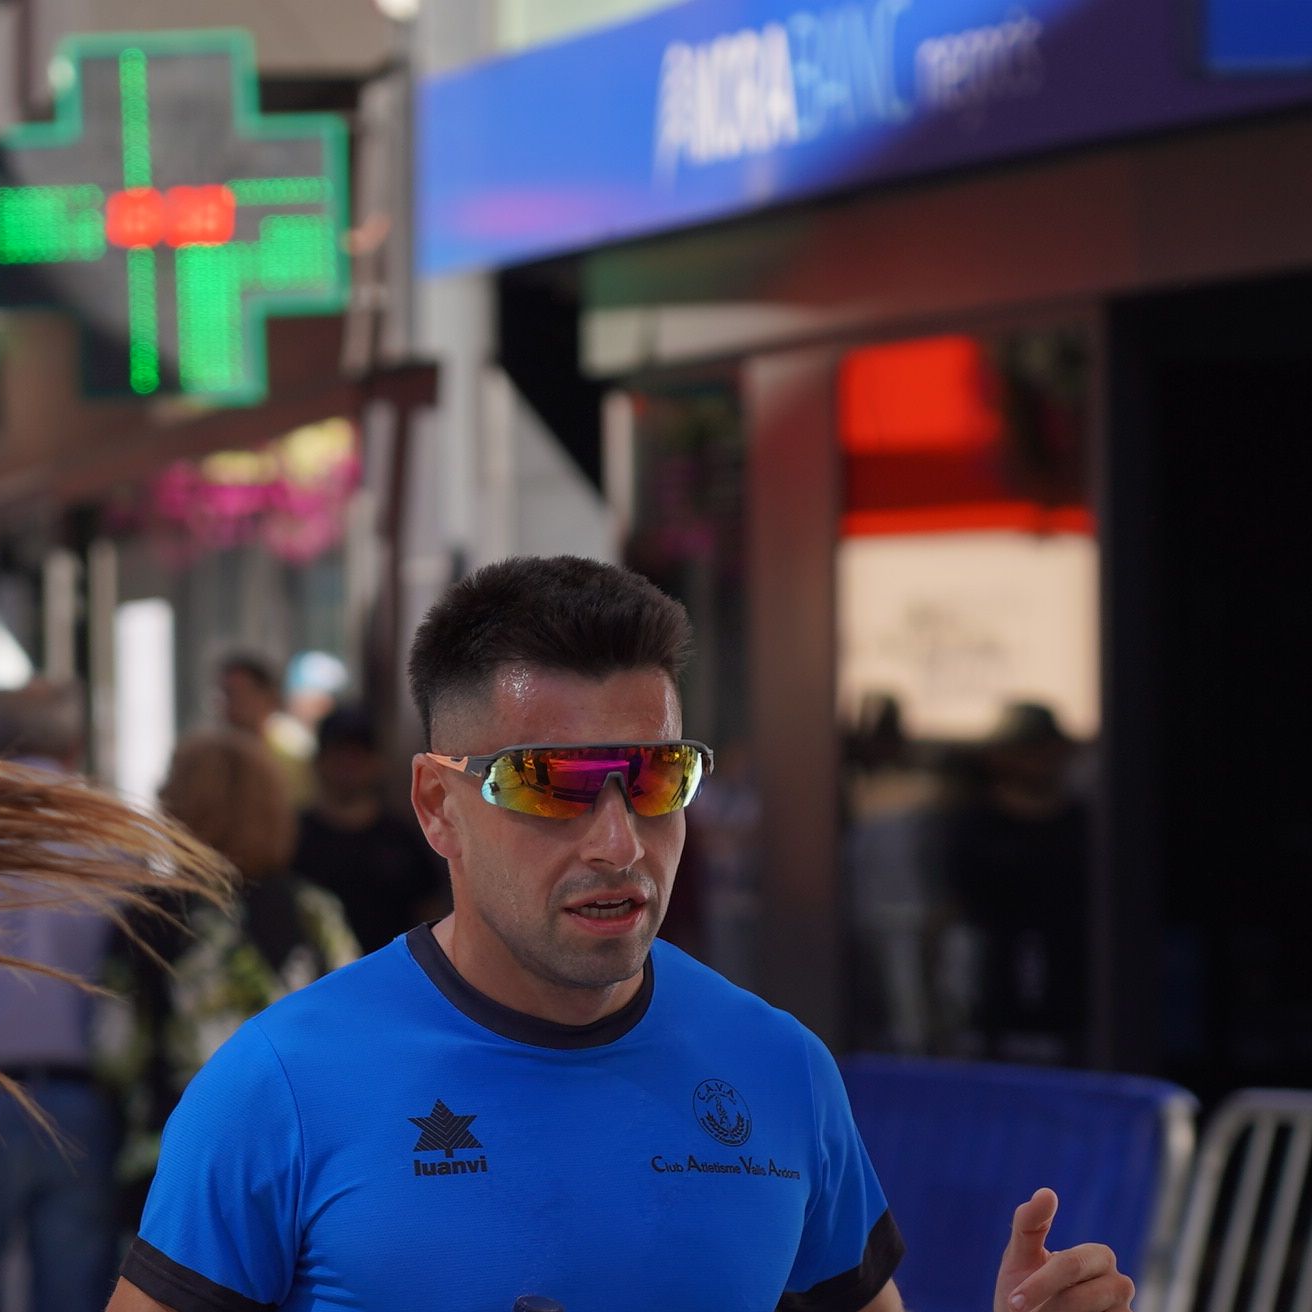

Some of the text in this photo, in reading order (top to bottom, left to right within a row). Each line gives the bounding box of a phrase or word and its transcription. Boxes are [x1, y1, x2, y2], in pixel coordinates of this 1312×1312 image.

[414, 1156, 487, 1176] luanvi
[651, 1155, 683, 1172] Club
[688, 1155, 740, 1174] Atletisme
